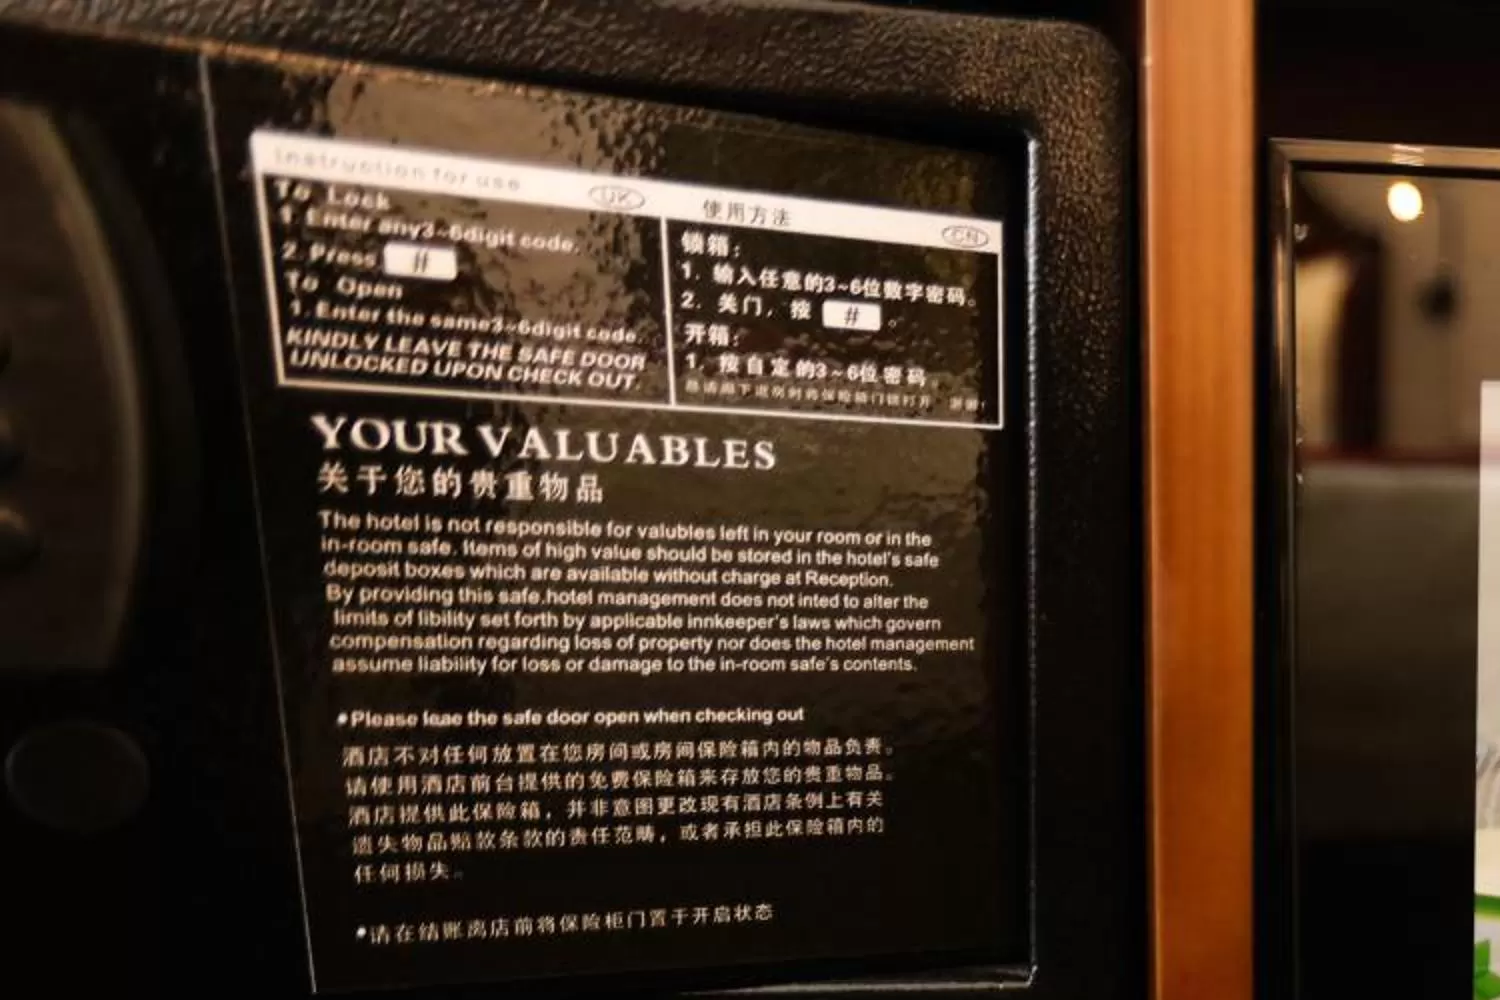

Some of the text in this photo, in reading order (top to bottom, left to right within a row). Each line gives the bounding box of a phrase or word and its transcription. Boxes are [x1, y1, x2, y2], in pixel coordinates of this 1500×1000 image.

[434, 166, 466, 186] for
[477, 176, 520, 192] use
[273, 178, 391, 211] To Lock
[305, 208, 370, 234] Enter
[703, 199, 792, 227] 使用方法
[309, 243, 378, 269] Press
[285, 271, 403, 302] To Open
[316, 302, 381, 326] Enter
[387, 306, 425, 328] the
[286, 325, 648, 372] KINDLY LEAVE THE SAFE DOOR
[289, 349, 429, 378] UNLOCKED
[433, 359, 503, 384] UPON
[507, 365, 583, 388] CHECK
[310, 414, 777, 471] YOUR VALUABLES
[317, 460, 604, 504] 关于您的贵重物品
[317, 508, 361, 531] The
[365, 510, 420, 533] hotel
[425, 513, 443, 533] is
[447, 515, 482, 534] not
[486, 515, 601, 539] responsible
[606, 517, 634, 539] for
[720, 525, 750, 542] left
[753, 525, 770, 543] in
[773, 529, 813, 547] your
[817, 530, 862, 546] room
[865, 531, 884, 547] or
[886, 530, 902, 547] in
[905, 530, 933, 548] the
[320, 534, 402, 557] in-room
[463, 538, 518, 559] Items
[522, 538, 544, 559] of
[546, 541, 587, 562] high
[591, 541, 642, 561] value
[647, 545, 708, 564] should
[711, 546, 733, 564] be
[737, 547, 793, 566] stored
[797, 549, 812, 566] in
[815, 549, 843, 567] the
[904, 552, 941, 569] safe
[323, 559, 400, 581] deposit
[404, 561, 466, 580] boxes
[469, 562, 526, 581] which
[531, 564, 563, 582] are
[566, 563, 650, 584] available
[653, 566, 719, 585] without
[721, 569, 782, 589] charge
[785, 570, 802, 588] at
[324, 582, 354, 607] By
[358, 583, 455, 608] providing
[458, 585, 495, 605] this
[599, 589, 717, 611] management
[720, 591, 764, 609] does
[767, 592, 795, 609] not
[798, 592, 840, 610] inted
[843, 594, 860, 610] to
[863, 594, 901, 611] alter
[904, 594, 930, 611] the
[333, 606, 390, 628] limits
[393, 607, 416, 628] of
[418, 608, 476, 631] libility
[479, 610, 512, 629] set
[515, 609, 559, 630] forth
[562, 611, 587, 632] by
[590, 611, 684, 633] applicable
[793, 614, 832, 631] laws
[834, 615, 884, 632] which
[886, 616, 943, 635] govern
[329, 630, 976, 656] compensation regarding loss of property nor does the hotel management
[332, 655, 414, 674] assume
[417, 652, 488, 677] liability
[491, 653, 518, 673] for
[521, 653, 562, 673] loss
[564, 655, 585, 673] or
[588, 653, 663, 676] damage
[667, 655, 686, 673] to
[688, 655, 716, 673] the
[719, 654, 787, 673] in-room
[351, 709, 419, 729] Please
[467, 708, 498, 728] the
[502, 708, 543, 727] safe
[546, 707, 589, 726] door
[593, 708, 640, 727] open
[644, 706, 692, 725] when
[695, 706, 774, 727] checking
[777, 706, 806, 723] out
